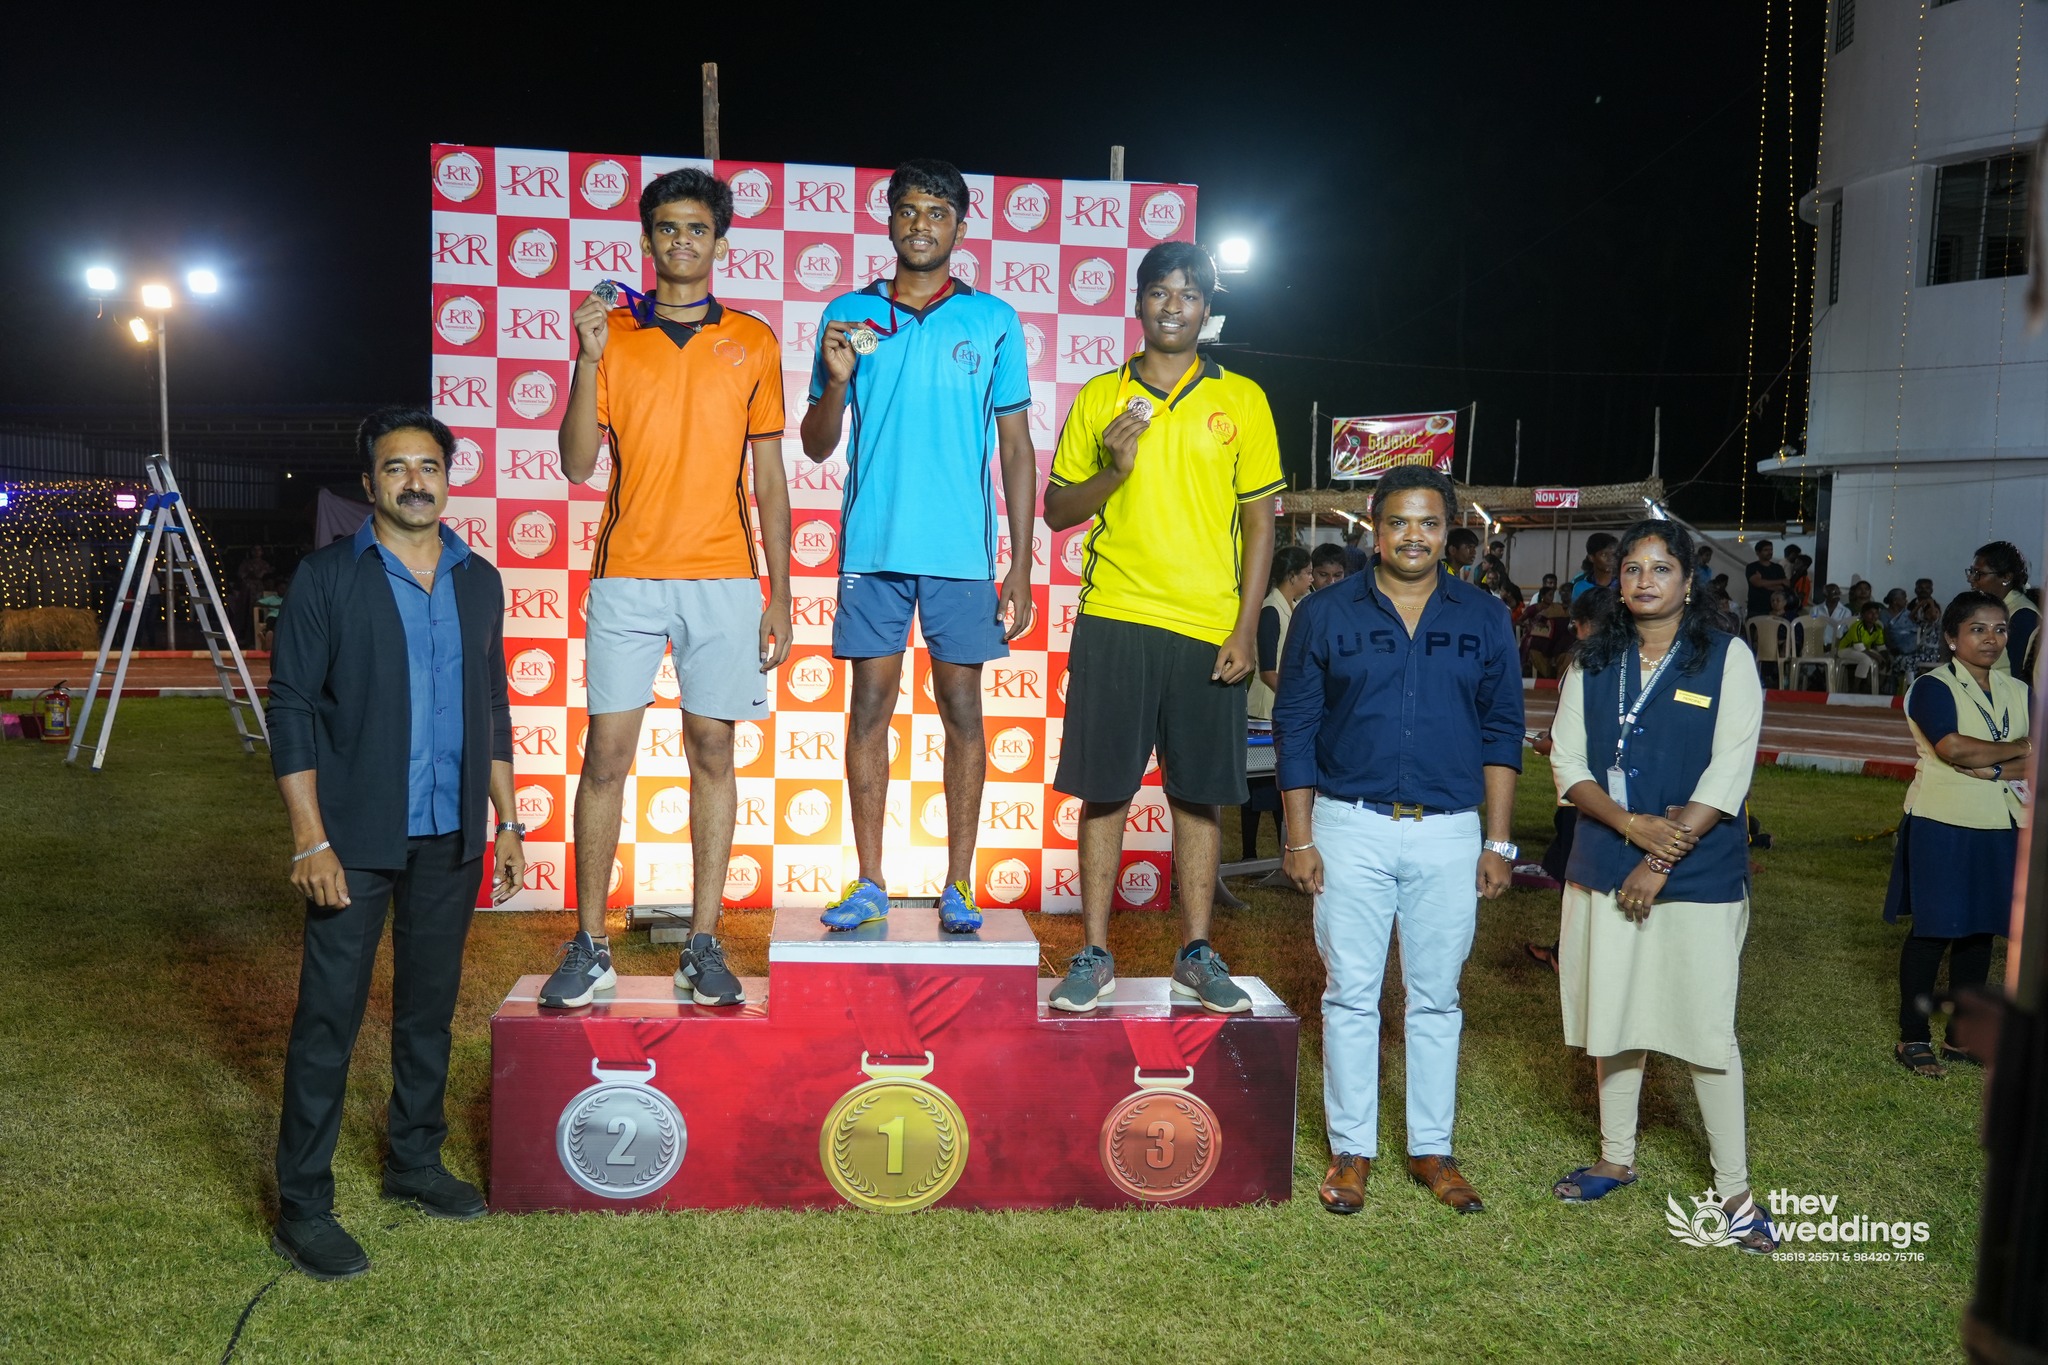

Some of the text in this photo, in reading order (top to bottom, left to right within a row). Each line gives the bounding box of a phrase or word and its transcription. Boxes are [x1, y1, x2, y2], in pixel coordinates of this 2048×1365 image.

[443, 165, 473, 181] RR
[501, 165, 565, 198] RR
[590, 173, 620, 189] RR
[734, 181, 763, 198] RR
[788, 181, 850, 213] RR
[1012, 197, 1040, 212] RR
[1065, 195, 1125, 228] RR
[1148, 204, 1175, 219] RR
[432, 232, 493, 266] RR
[518, 241, 547, 257] RR
[574, 240, 637, 272] RR
[804, 256, 832, 271] RR
[717, 248, 779, 280] RR
[995, 261, 1054, 294] RR
[1078, 271, 1105, 286] RR
[445, 309, 475, 325] RR
[502, 308, 565, 340] RR
[1061, 335, 1119, 365] RR
[432, 375, 493, 408] RR
[517, 383, 547, 399] RR
[500, 449, 564, 480] RR
[787, 460, 843, 490] RR
[517, 523, 547, 539] RR
[799, 532, 826, 547] RR
[504, 588, 564, 619] RR
[516, 661, 546, 676] RR
[796, 667, 824, 682] RR
[984, 668, 1043, 698] RR
[781, 730, 839, 760] RR
[997, 739, 1024, 753] RR
[981, 801, 1039, 830] RR
[777, 864, 836, 892] RR
[995, 871, 1022, 885] RR
[1125, 873, 1152, 886] RR
[606, 1116, 638, 1166] 2
[877, 1116, 905, 1175] 1
[1146, 1121, 1176, 1169] 3
